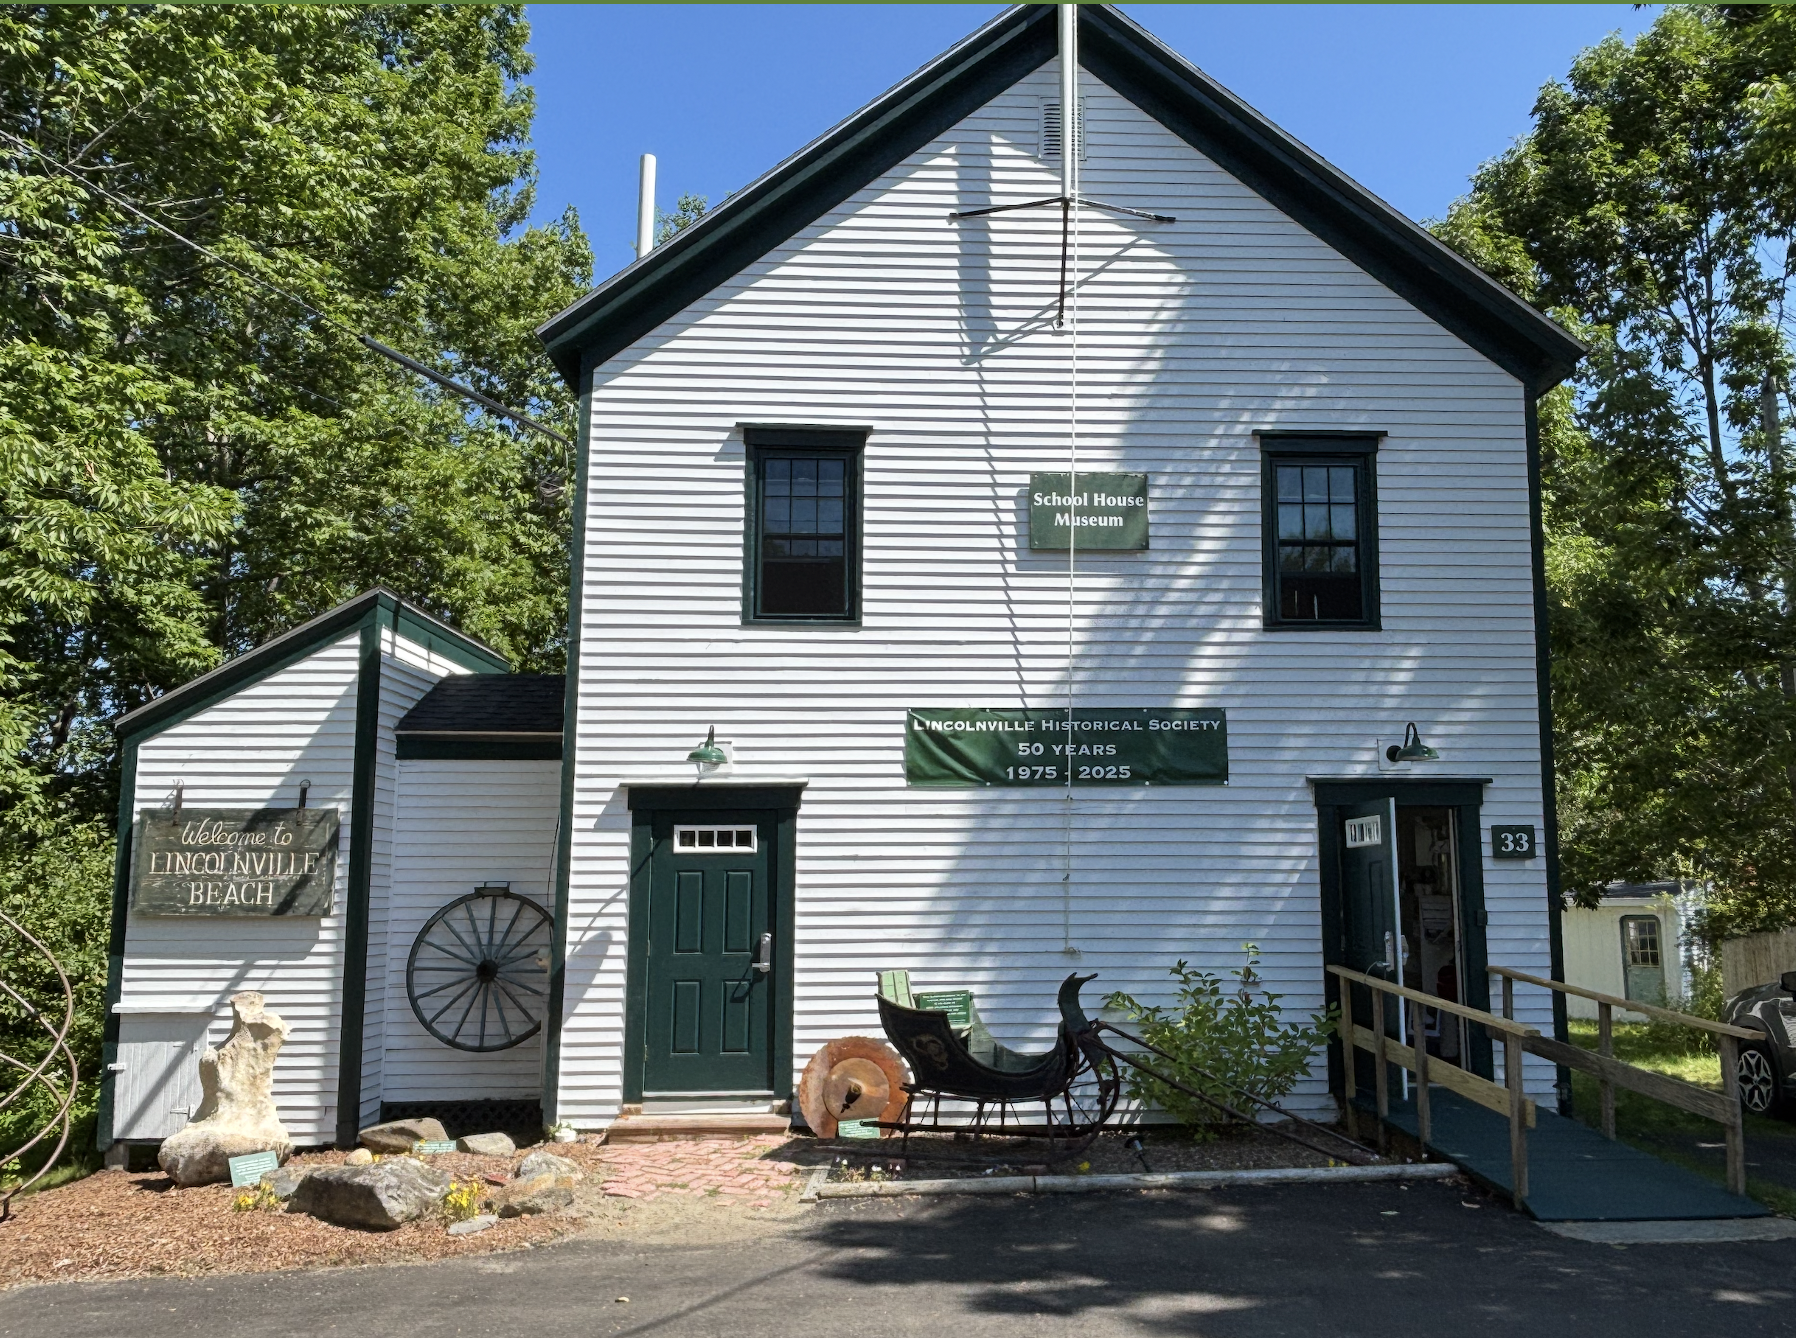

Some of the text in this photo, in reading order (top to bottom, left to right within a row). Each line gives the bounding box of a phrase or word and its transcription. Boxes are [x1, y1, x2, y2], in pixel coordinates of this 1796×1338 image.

[1033, 492, 1144, 507] School House
[1054, 512, 1124, 527] Museum
[913, 718, 1221, 731] LINCOLNVILLE HISTORICAL SOCIETY
[1018, 743, 1117, 756] 50 YEARS
[1006, 766, 1058, 779] 1975
[1078, 765, 1131, 779] 2025
[181, 817, 293, 846] Welcome to
[1500, 832, 1529, 852] 33
[149, 852, 320, 875] LINCOLNVILLE
[189, 881, 273, 905] BEACH
